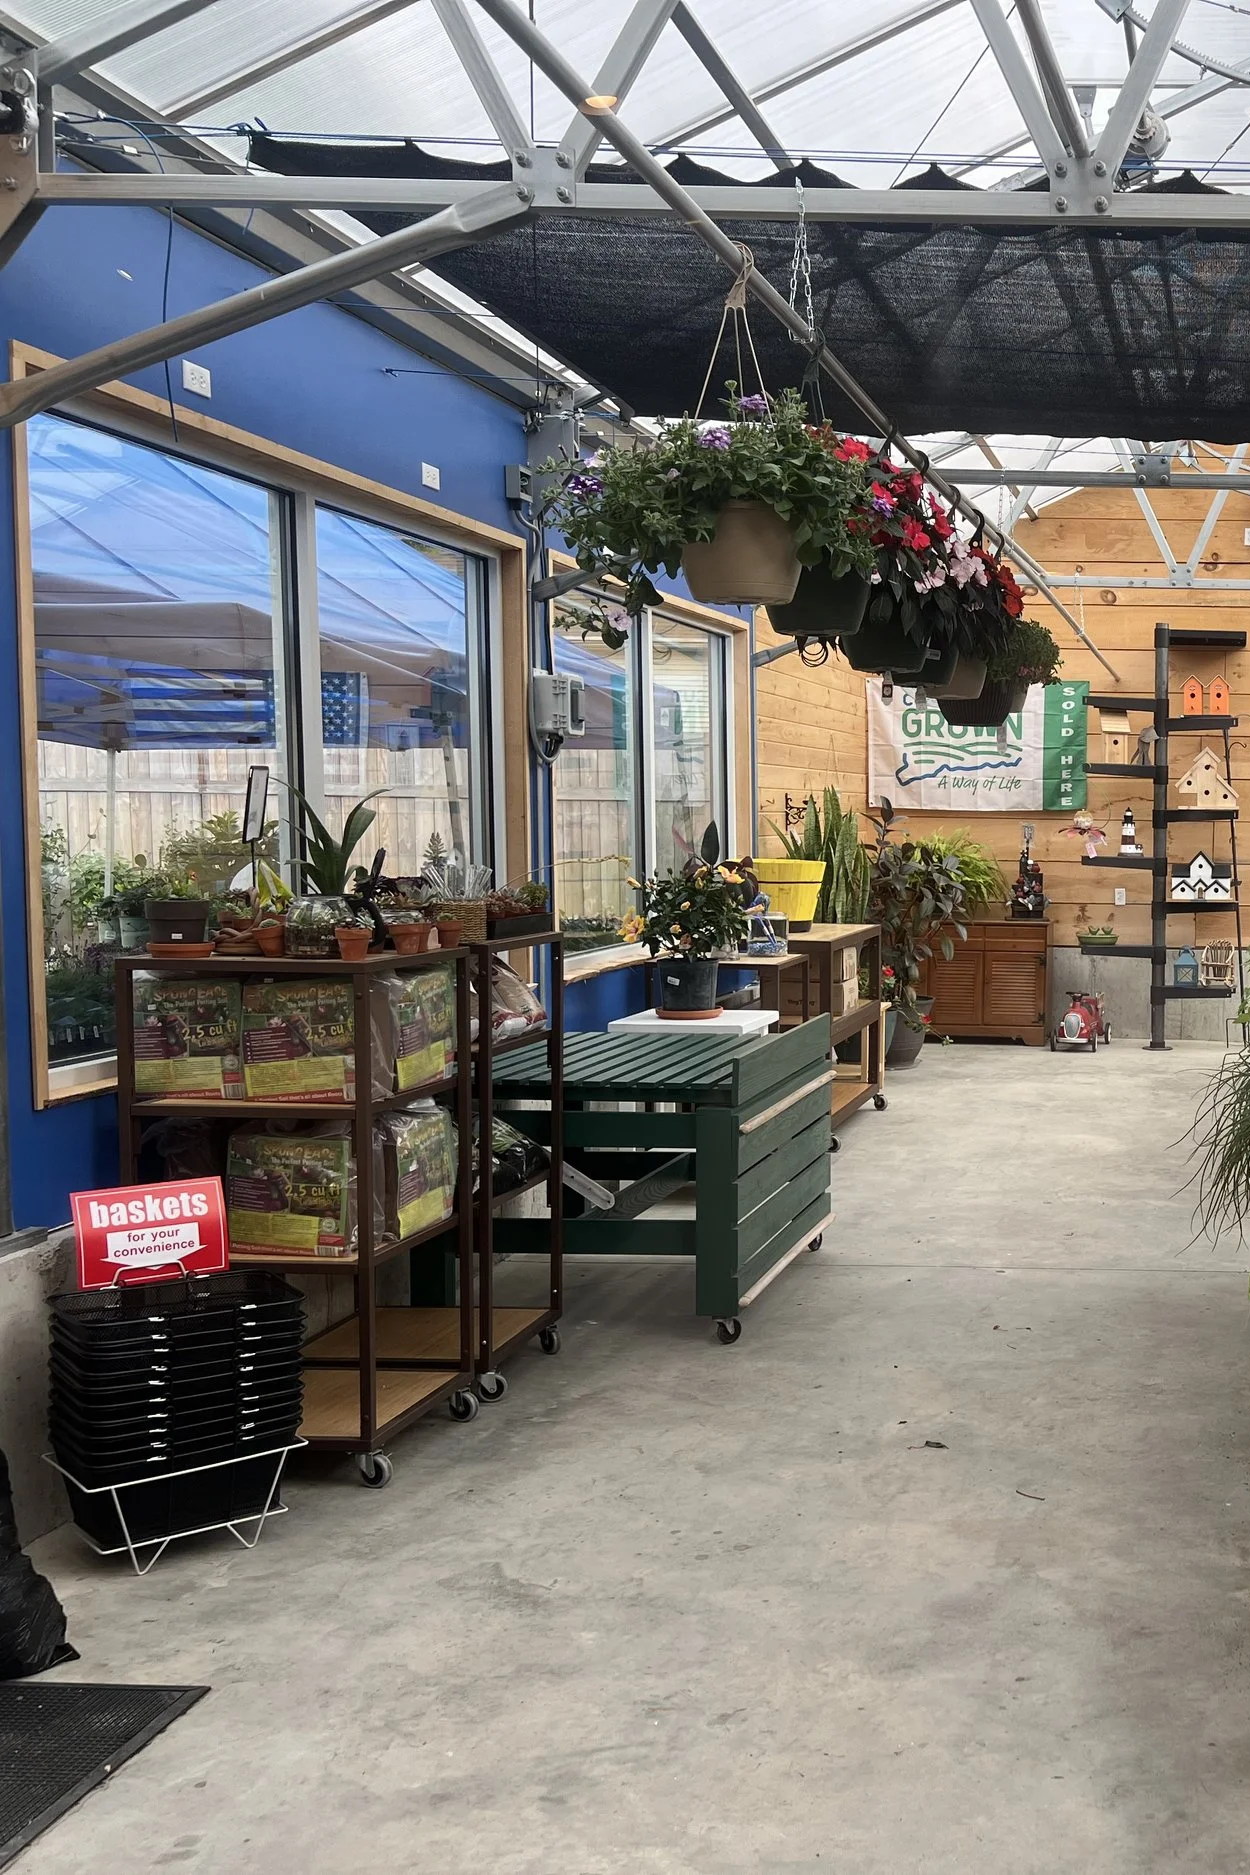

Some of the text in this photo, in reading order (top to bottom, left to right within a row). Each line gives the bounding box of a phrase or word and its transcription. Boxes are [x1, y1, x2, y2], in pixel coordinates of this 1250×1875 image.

[1060, 687, 1075, 806] SOLD HERE
[937, 775, 1023, 796] A Way of Life
[209, 1025, 223, 1036] cu
[227, 1019, 237, 1032] ft
[330, 1024, 345, 1036] cu
[311, 1186, 325, 1196] cu
[329, 1182, 340, 1195] ft
[89, 1192, 209, 1229] baskets
[127, 1228, 180, 1245] for your
[113, 1239, 195, 1258] convenience
